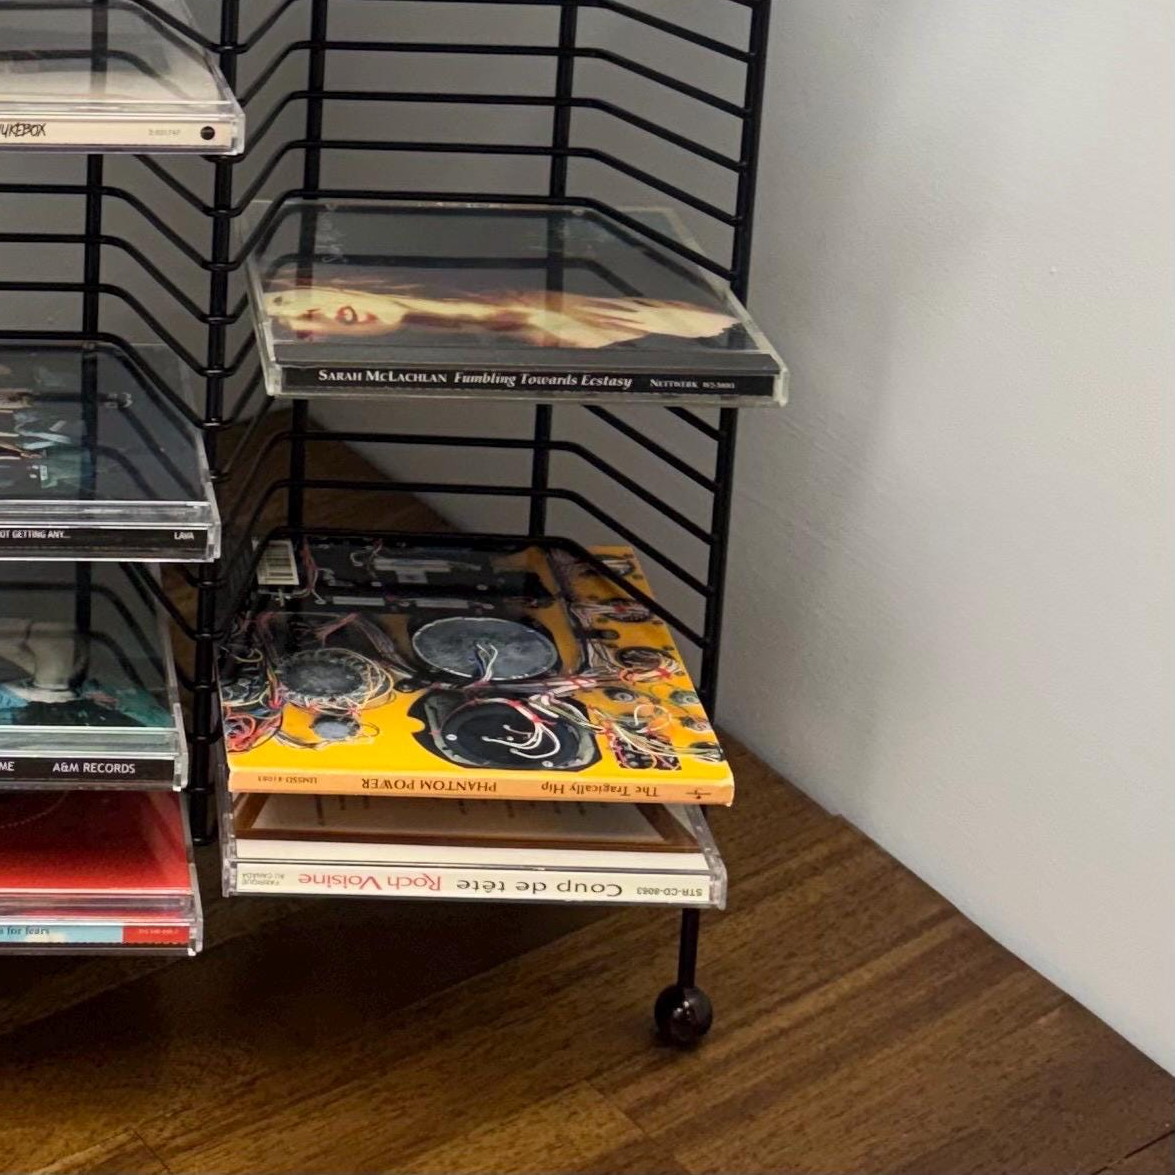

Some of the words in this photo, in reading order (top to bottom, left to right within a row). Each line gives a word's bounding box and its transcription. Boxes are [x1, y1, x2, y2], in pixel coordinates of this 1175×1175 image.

[318, 369, 362, 382] SARAH
[454, 371, 516, 388] Fumbling
[520, 373, 578, 386] Towards
[581, 374, 633, 390] Ecstasy
[12, 530, 46, 539] GETTING
[174, 531, 195, 540] LAVA
[52, 762, 79, 773] A&M
[83, 763, 136, 774] RECORDS
[361, 778, 415, 790] POWER
[420, 779, 497, 793] PHANTOM
[540, 782, 564, 795] Hip
[569, 782, 631, 797] Tragically
[636, 786, 661, 798] The
[297, 873, 383, 891] Voisine
[387, 873, 442, 892] Roch
[456, 880, 506, 895] tête
[515, 881, 547, 895] de
[556, 880, 623, 898] Coup
[7, 926, 22, 936] for
[25, 926, 50, 936] fears
